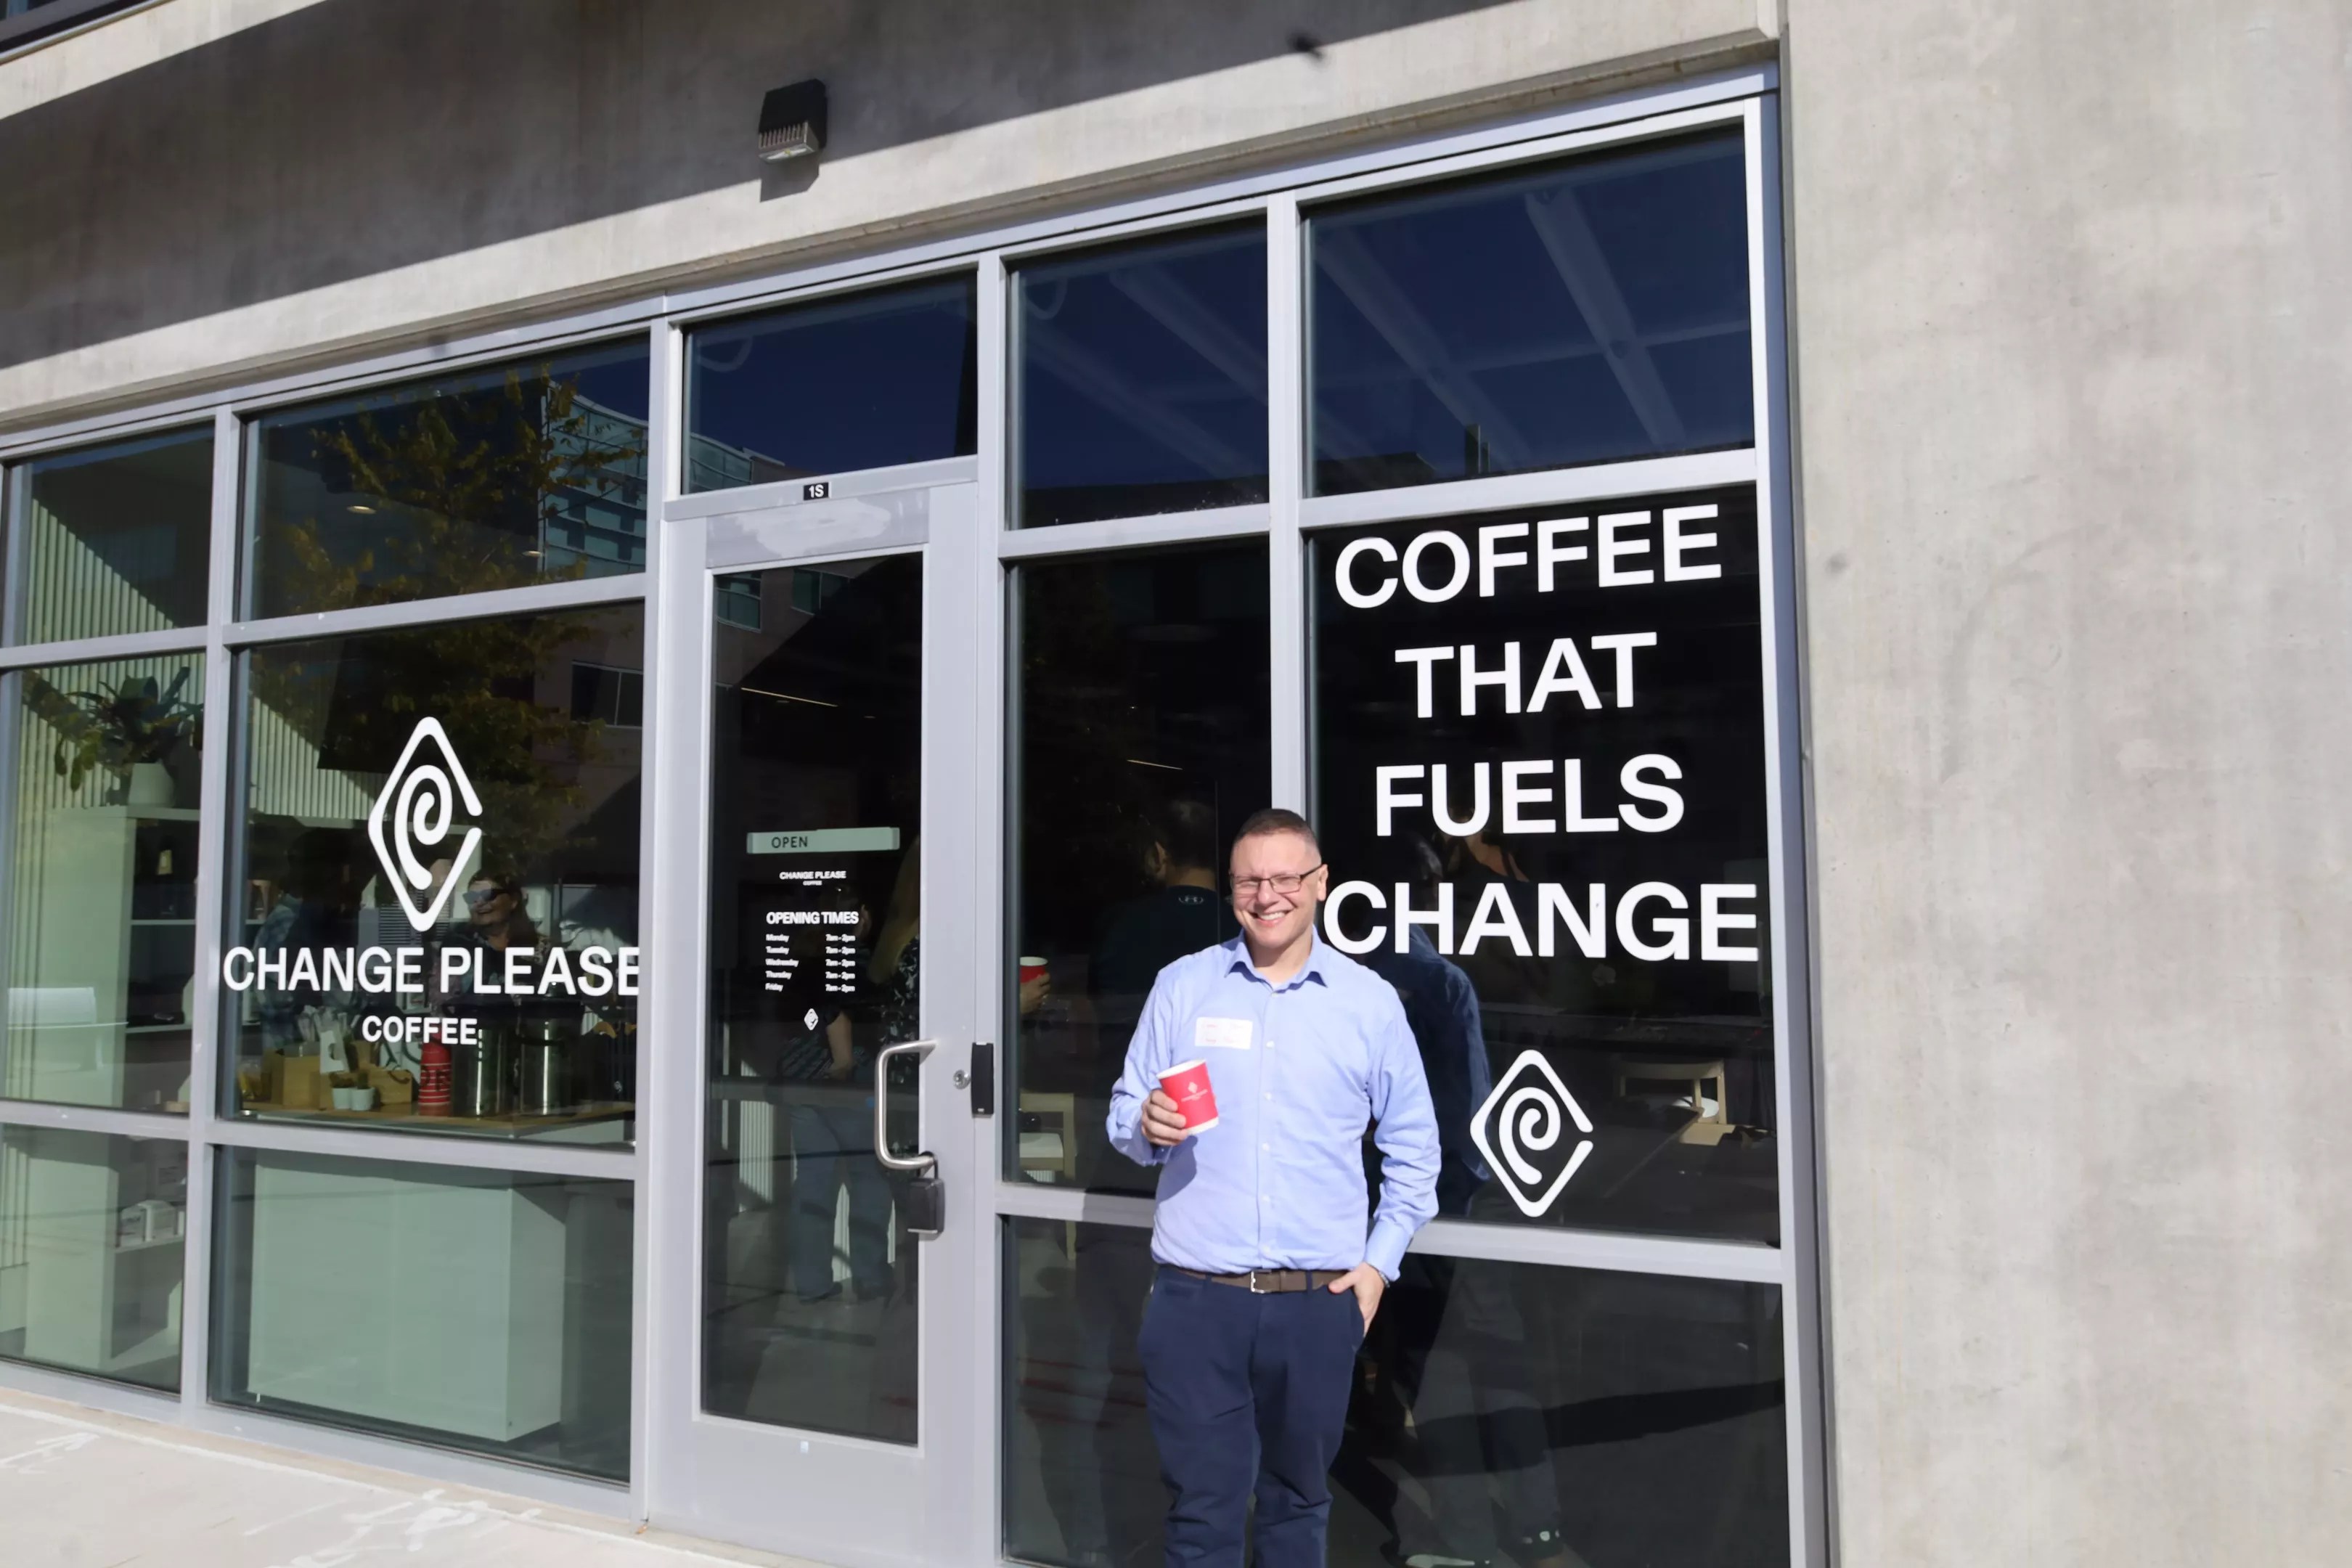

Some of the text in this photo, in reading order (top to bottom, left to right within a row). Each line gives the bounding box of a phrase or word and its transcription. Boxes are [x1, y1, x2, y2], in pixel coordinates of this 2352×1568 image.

[808, 483, 825, 499] 1S
[1334, 503, 1722, 609] COFFEE
[1394, 631, 1658, 719] THAT
[1376, 753, 1685, 837] FUELS
[770, 836, 809, 849] OPEN
[779, 870, 847, 880] CHANGE PLEASE
[766, 911, 860, 926] OPENING TIMES
[1323, 880, 1759, 962] CHANGE
[223, 945, 640, 997] CHANGE PLEASE
[765, 983, 783, 992] Friday
[362, 1015, 478, 1045] COFFEE
